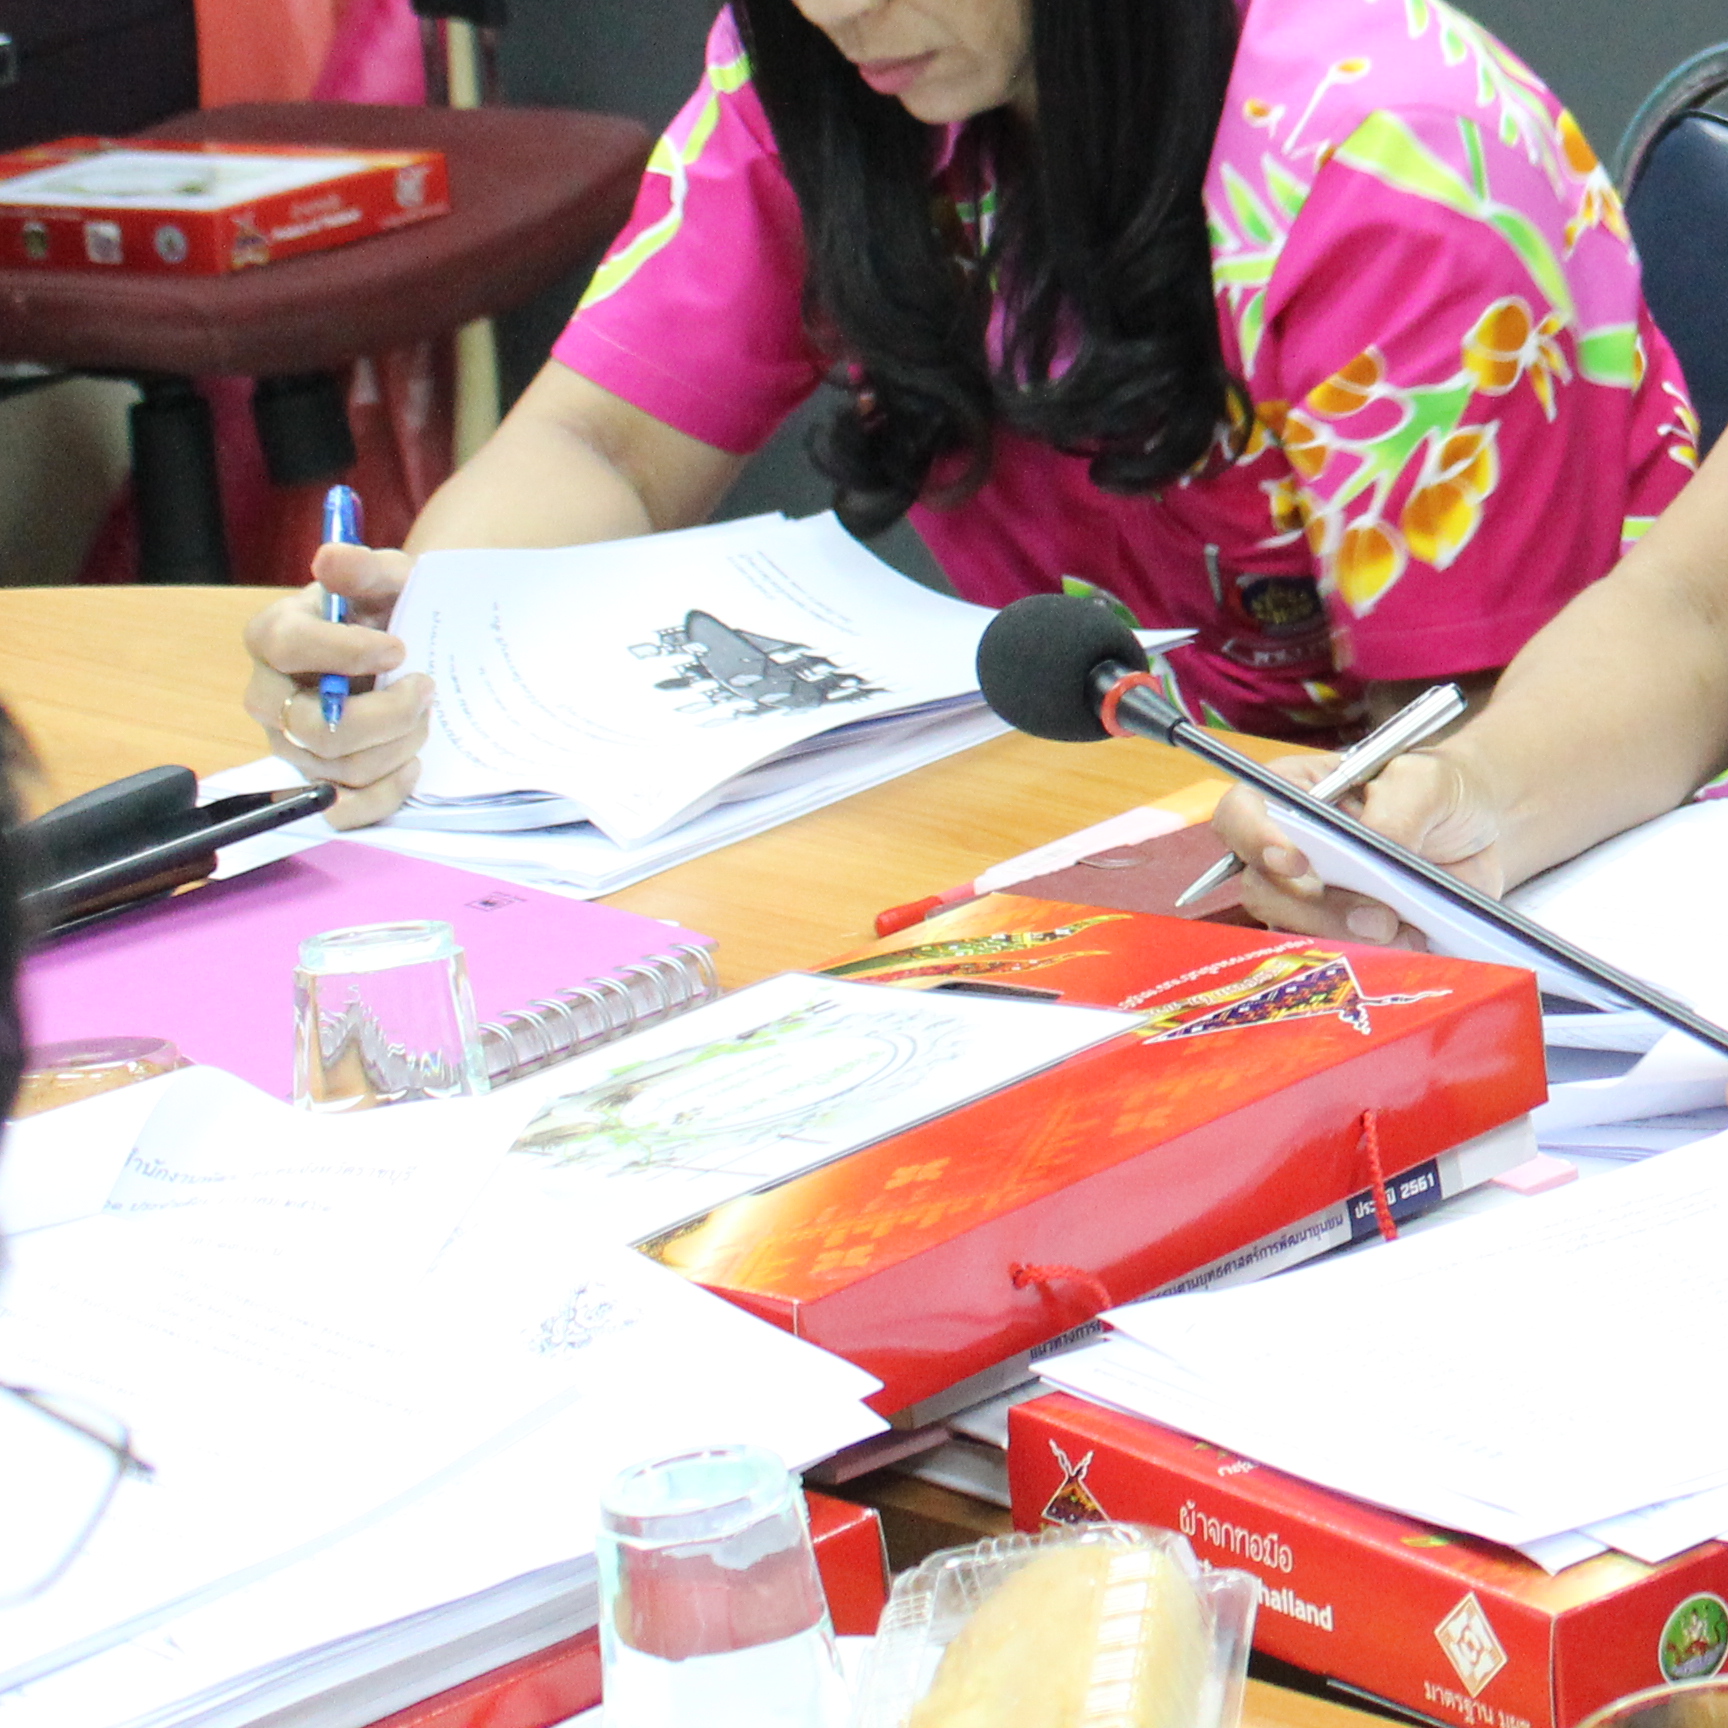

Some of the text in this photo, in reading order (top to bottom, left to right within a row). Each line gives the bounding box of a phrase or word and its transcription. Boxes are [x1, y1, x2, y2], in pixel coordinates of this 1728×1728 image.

[1400, 1171, 1435, 1200] 2561
[1178, 1500, 1294, 1573] ผ้าจกทอมือ
[1257, 1576, 1334, 1633] hailand
[1423, 1679, 1495, 1725] มาตรฐาน
